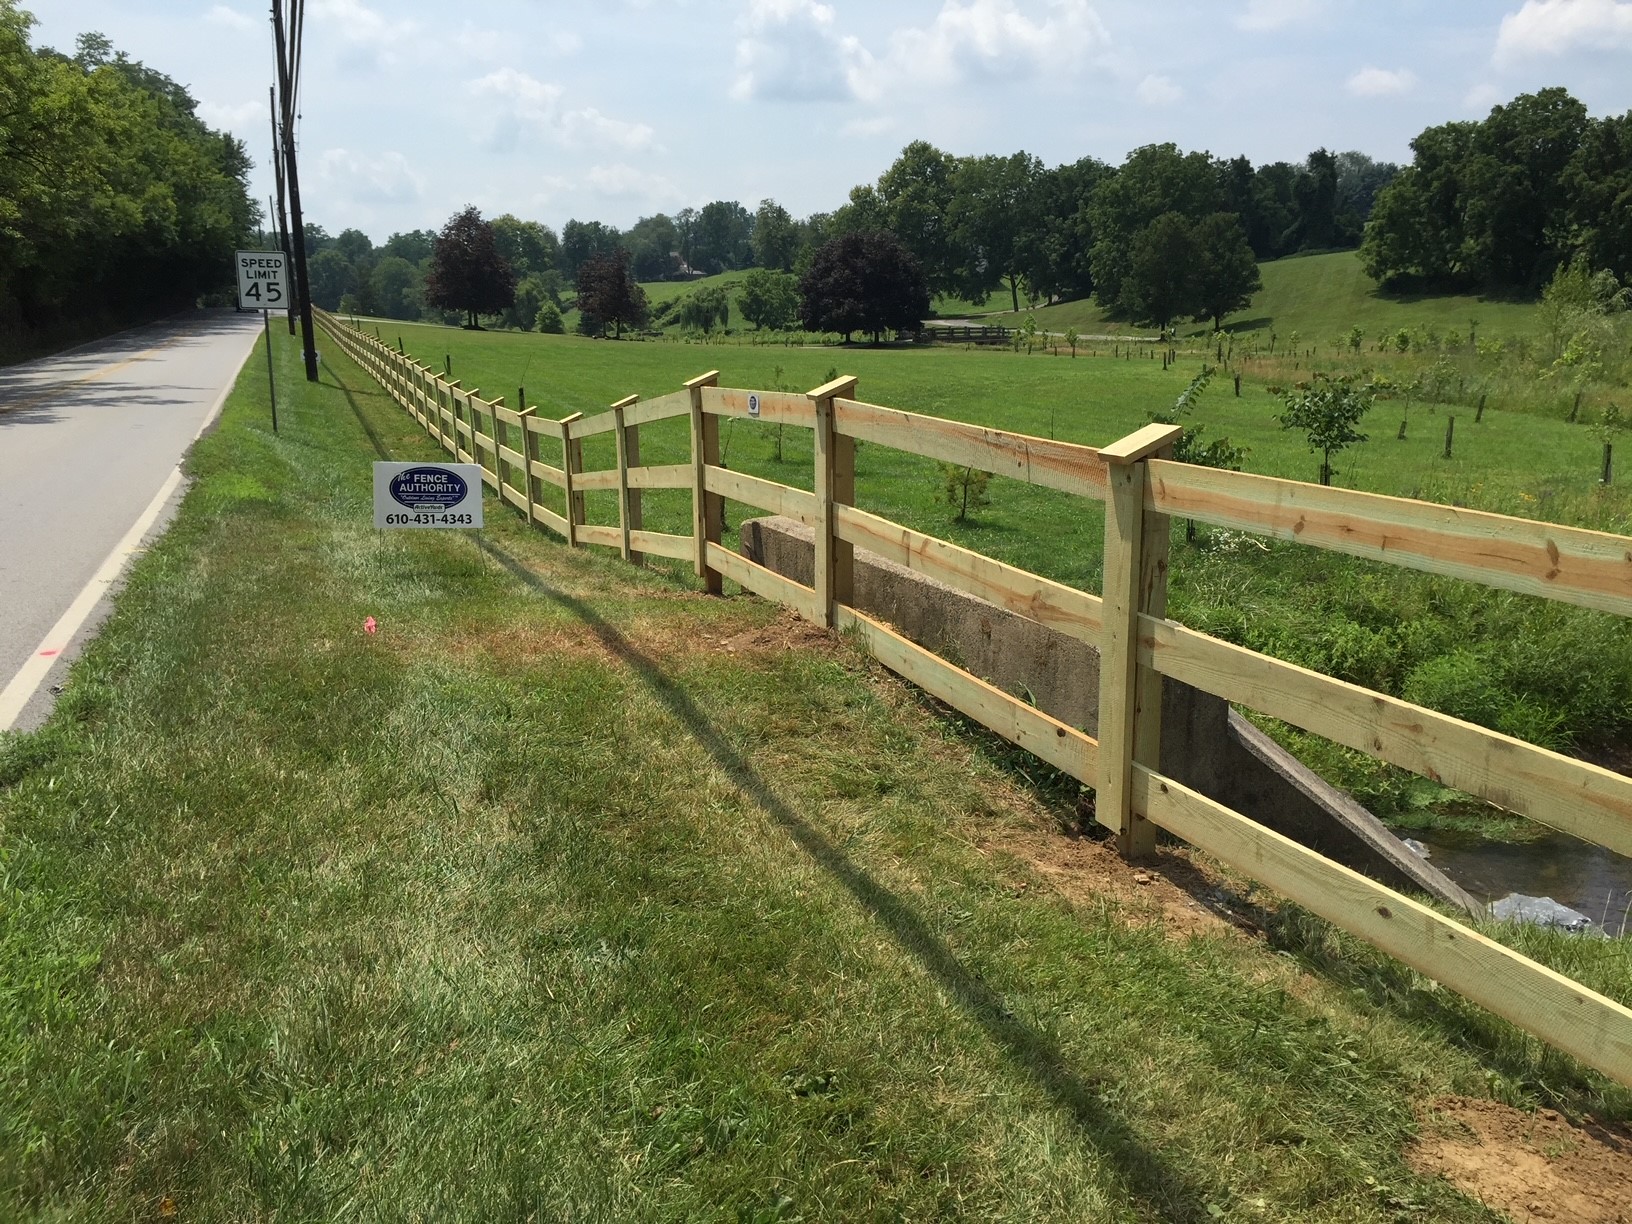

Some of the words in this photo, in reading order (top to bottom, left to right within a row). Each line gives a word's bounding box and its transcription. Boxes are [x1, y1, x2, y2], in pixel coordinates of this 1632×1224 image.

[241, 258, 282, 268] SPEED
[246, 270, 278, 279] LIMIT
[245, 282, 282, 302] 45
[414, 474, 448, 483] FENCE
[399, 484, 461, 492] AUTHORITY
[386, 514, 472, 524] 610-431-4343
